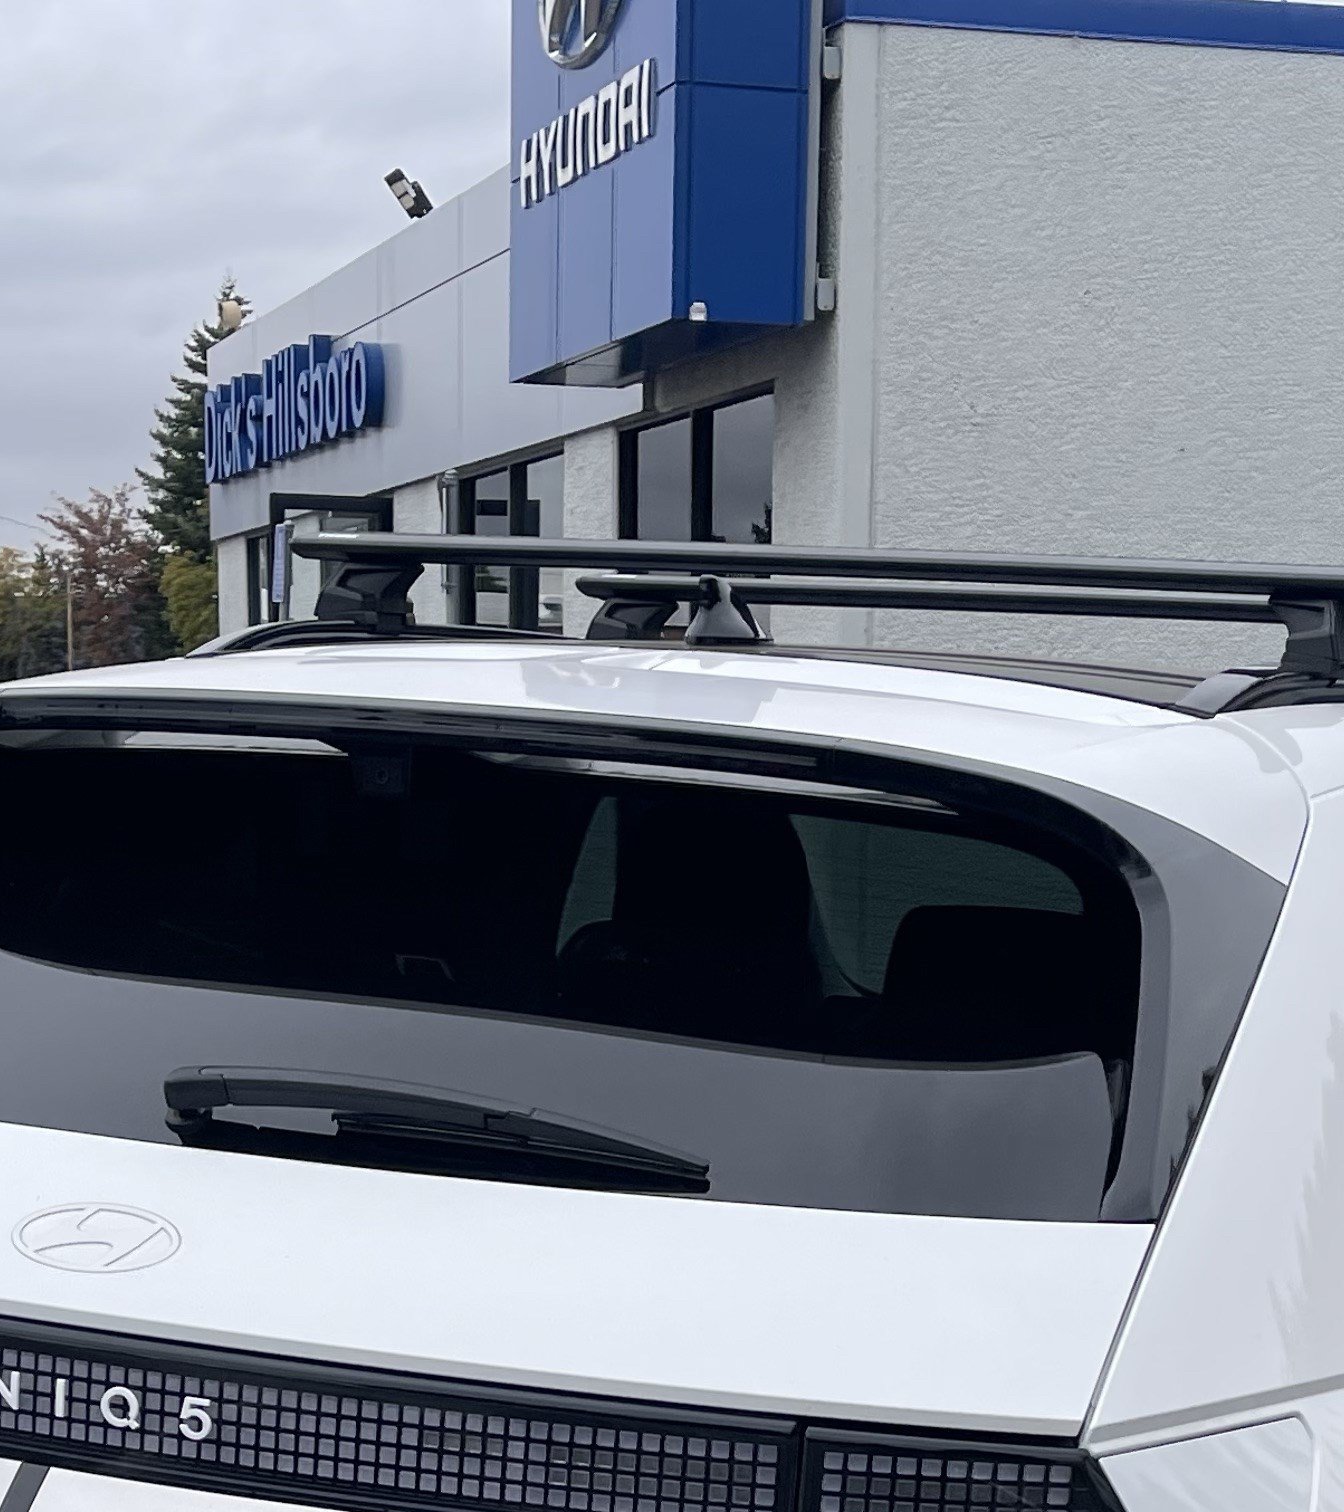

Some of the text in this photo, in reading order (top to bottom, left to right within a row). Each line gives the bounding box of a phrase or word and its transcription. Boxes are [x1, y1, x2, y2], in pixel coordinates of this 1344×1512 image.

[520, 58, 652, 209] HYUNDAI
[204, 334, 370, 485] Dick's Hillsboro
[178, 1396, 214, 1441] 5
